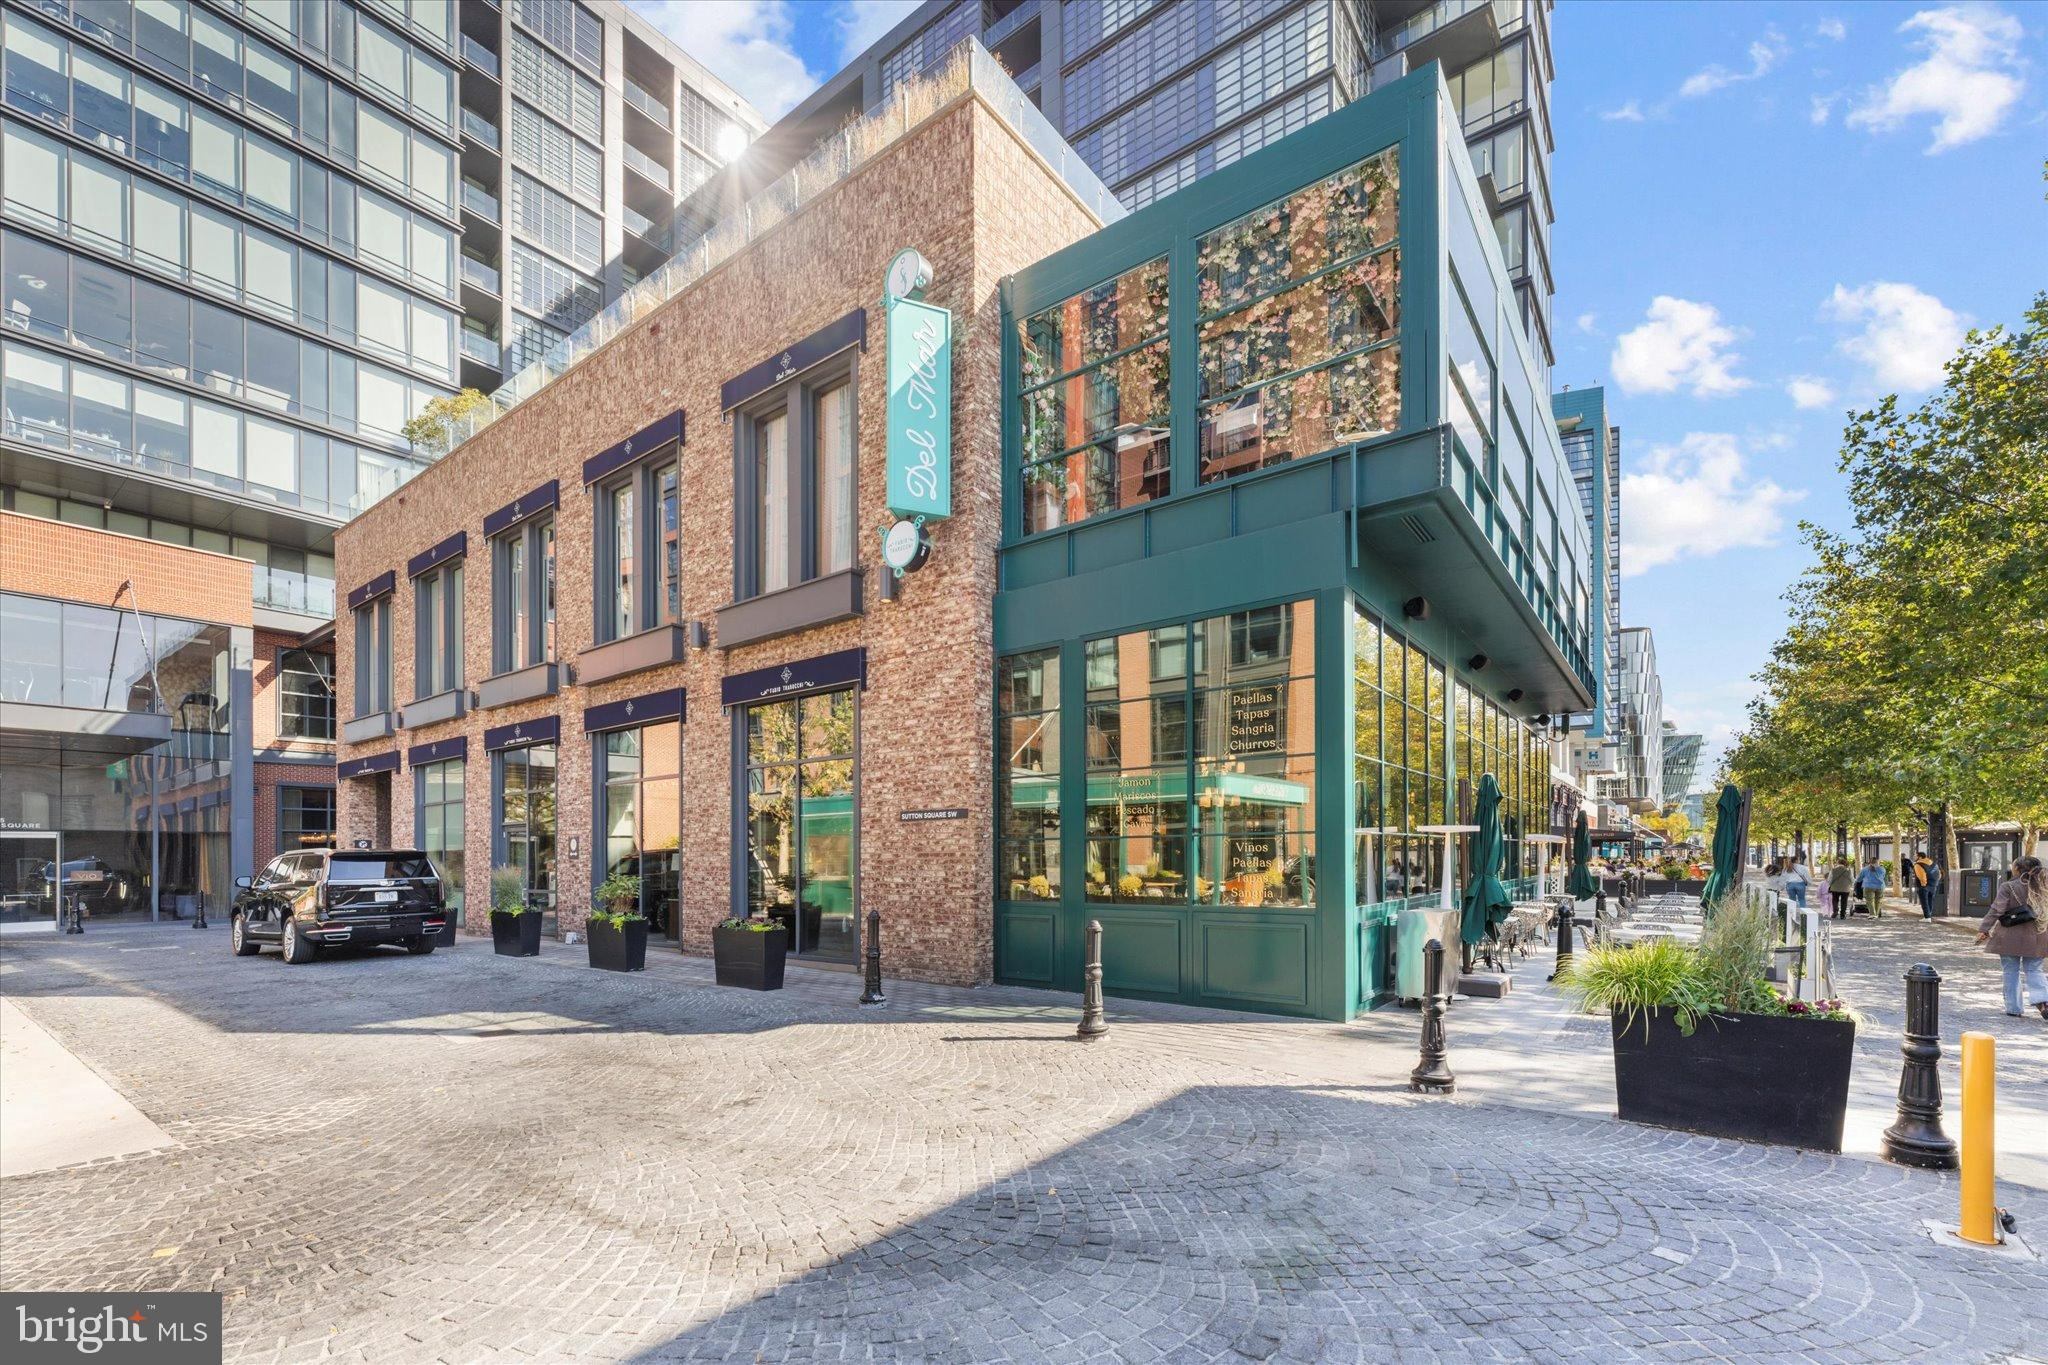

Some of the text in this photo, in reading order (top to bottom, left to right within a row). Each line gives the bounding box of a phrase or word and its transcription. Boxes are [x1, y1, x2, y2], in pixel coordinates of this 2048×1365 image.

[906, 318, 937, 501] Del Mar
[1233, 692, 1273, 706] Paellas
[1235, 709, 1270, 722] Tapas
[1231, 722, 1275, 736] Sangria
[1229, 739, 1276, 751] Churros
[1118, 777, 1152, 788] Jamon
[1113, 791, 1157, 802] Mariscos
[901, 810, 958, 820] SUTTON SQUARE SW
[1115, 804, 1155, 815] Pescado
[1235, 842, 1269, 853] Vinos
[1233, 856, 1273, 868] Paellas
[1235, 872, 1270, 885] Tapas
[1231, 887, 1275, 900] Sangria
